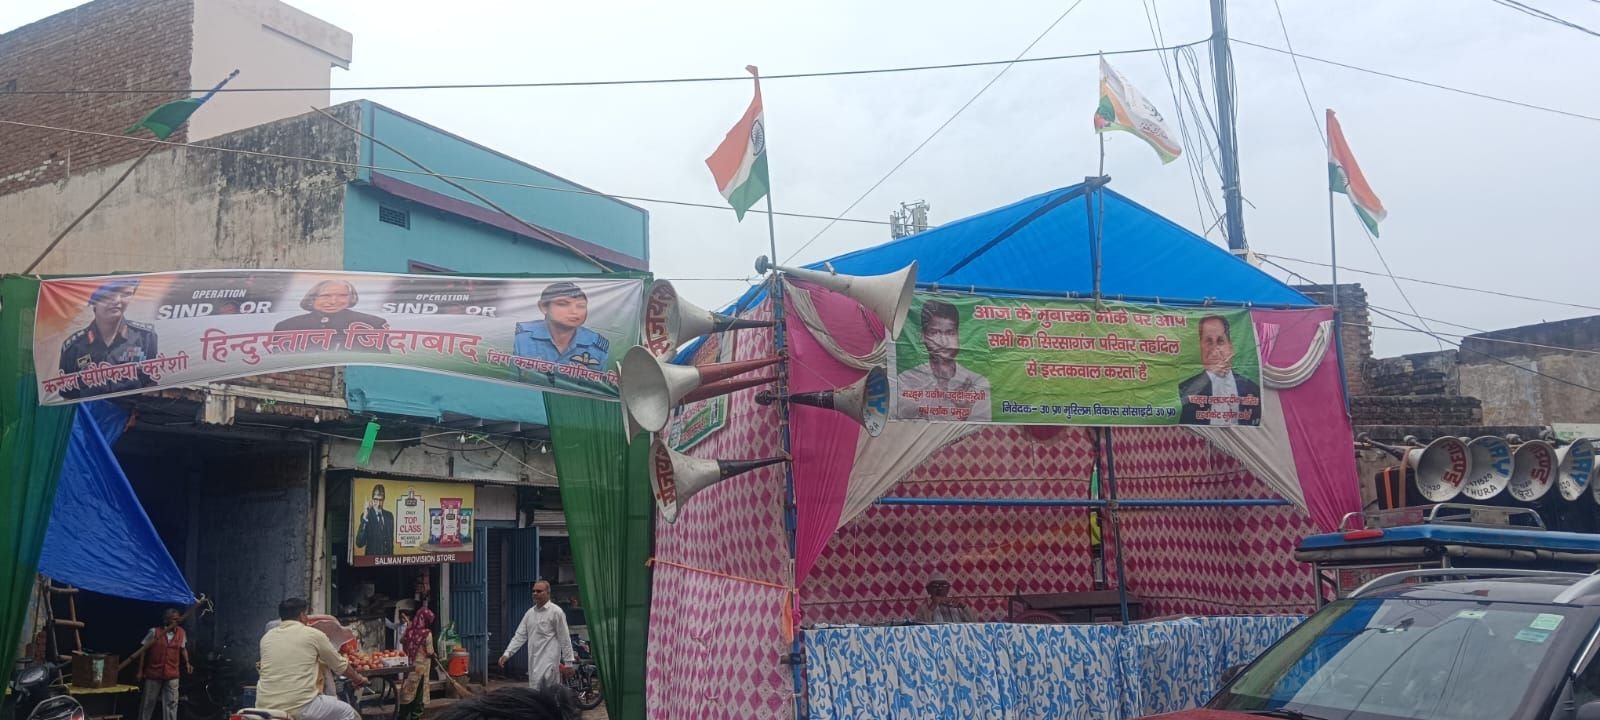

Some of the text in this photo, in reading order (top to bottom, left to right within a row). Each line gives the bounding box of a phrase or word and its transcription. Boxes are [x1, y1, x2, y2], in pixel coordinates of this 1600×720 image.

[192, 289, 247, 300] OPERATION
[415, 293, 470, 302] OPERATION
[157, 301, 273, 320] SIND OR
[383, 302, 497, 318] SIND OR
[974, 304, 1012, 320] आज
[1014, 303, 1034, 320] के
[1132, 312, 1153, 326] पर
[1155, 313, 1187, 328] आप
[200, 322, 482, 365] हिन्दुस्तान जिंदाबाद
[987, 328, 1181, 354] सभी का सिरसागंज परिवार तहदिल
[1025, 358, 1038, 377] से
[1039, 363, 1102, 380] इस्तकवाल
[1103, 364, 1137, 379] करता
[404, 516, 418, 524] TOP
[399, 525, 422, 533] CLASS
[375, 553, 456, 565] SALMAN PROVISION STORE
